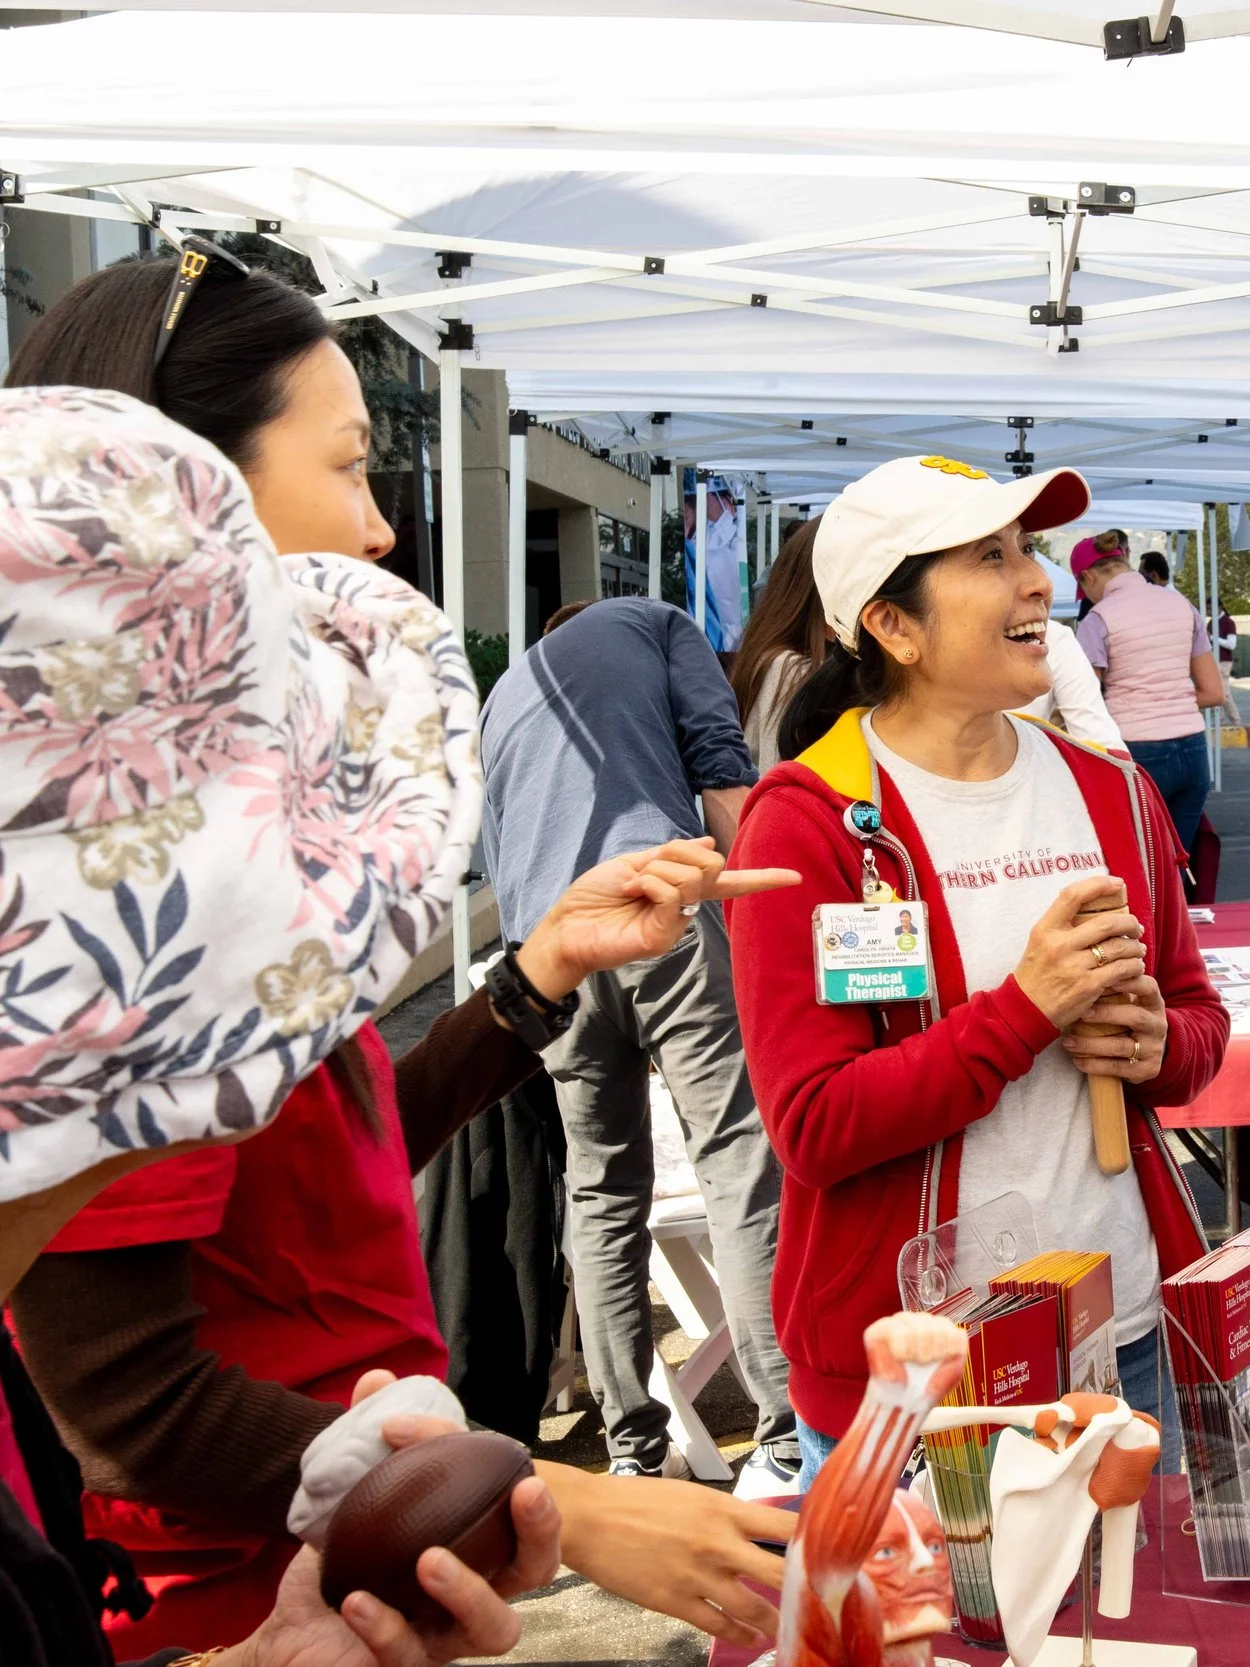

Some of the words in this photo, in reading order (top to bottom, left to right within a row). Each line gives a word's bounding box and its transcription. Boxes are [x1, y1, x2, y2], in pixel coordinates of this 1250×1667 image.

[852, 810, 880, 828] PT
[1036, 847, 1052, 858] OF
[830, 915, 846, 925] USC
[847, 915, 876, 925] Verdugo
[830, 924, 848, 933] Hills
[849, 923, 878, 934] Hospital
[847, 970, 903, 988] Physical
[845, 983, 908, 1001] Therapist
[1225, 1286, 1236, 1299] USC
[1234, 1279, 1250, 1293] Verdugo
[1225, 1297, 1237, 1311] Hills
[1228, 1325, 1249, 1345] Cardiac
[1229, 1347, 1237, 1360] &
[992, 1366, 1007, 1381] USC
[1006, 1360, 1029, 1375] Verdugo
[993, 1379, 1009, 1395] Hills
[1008, 1369, 1030, 1388] Hospital
